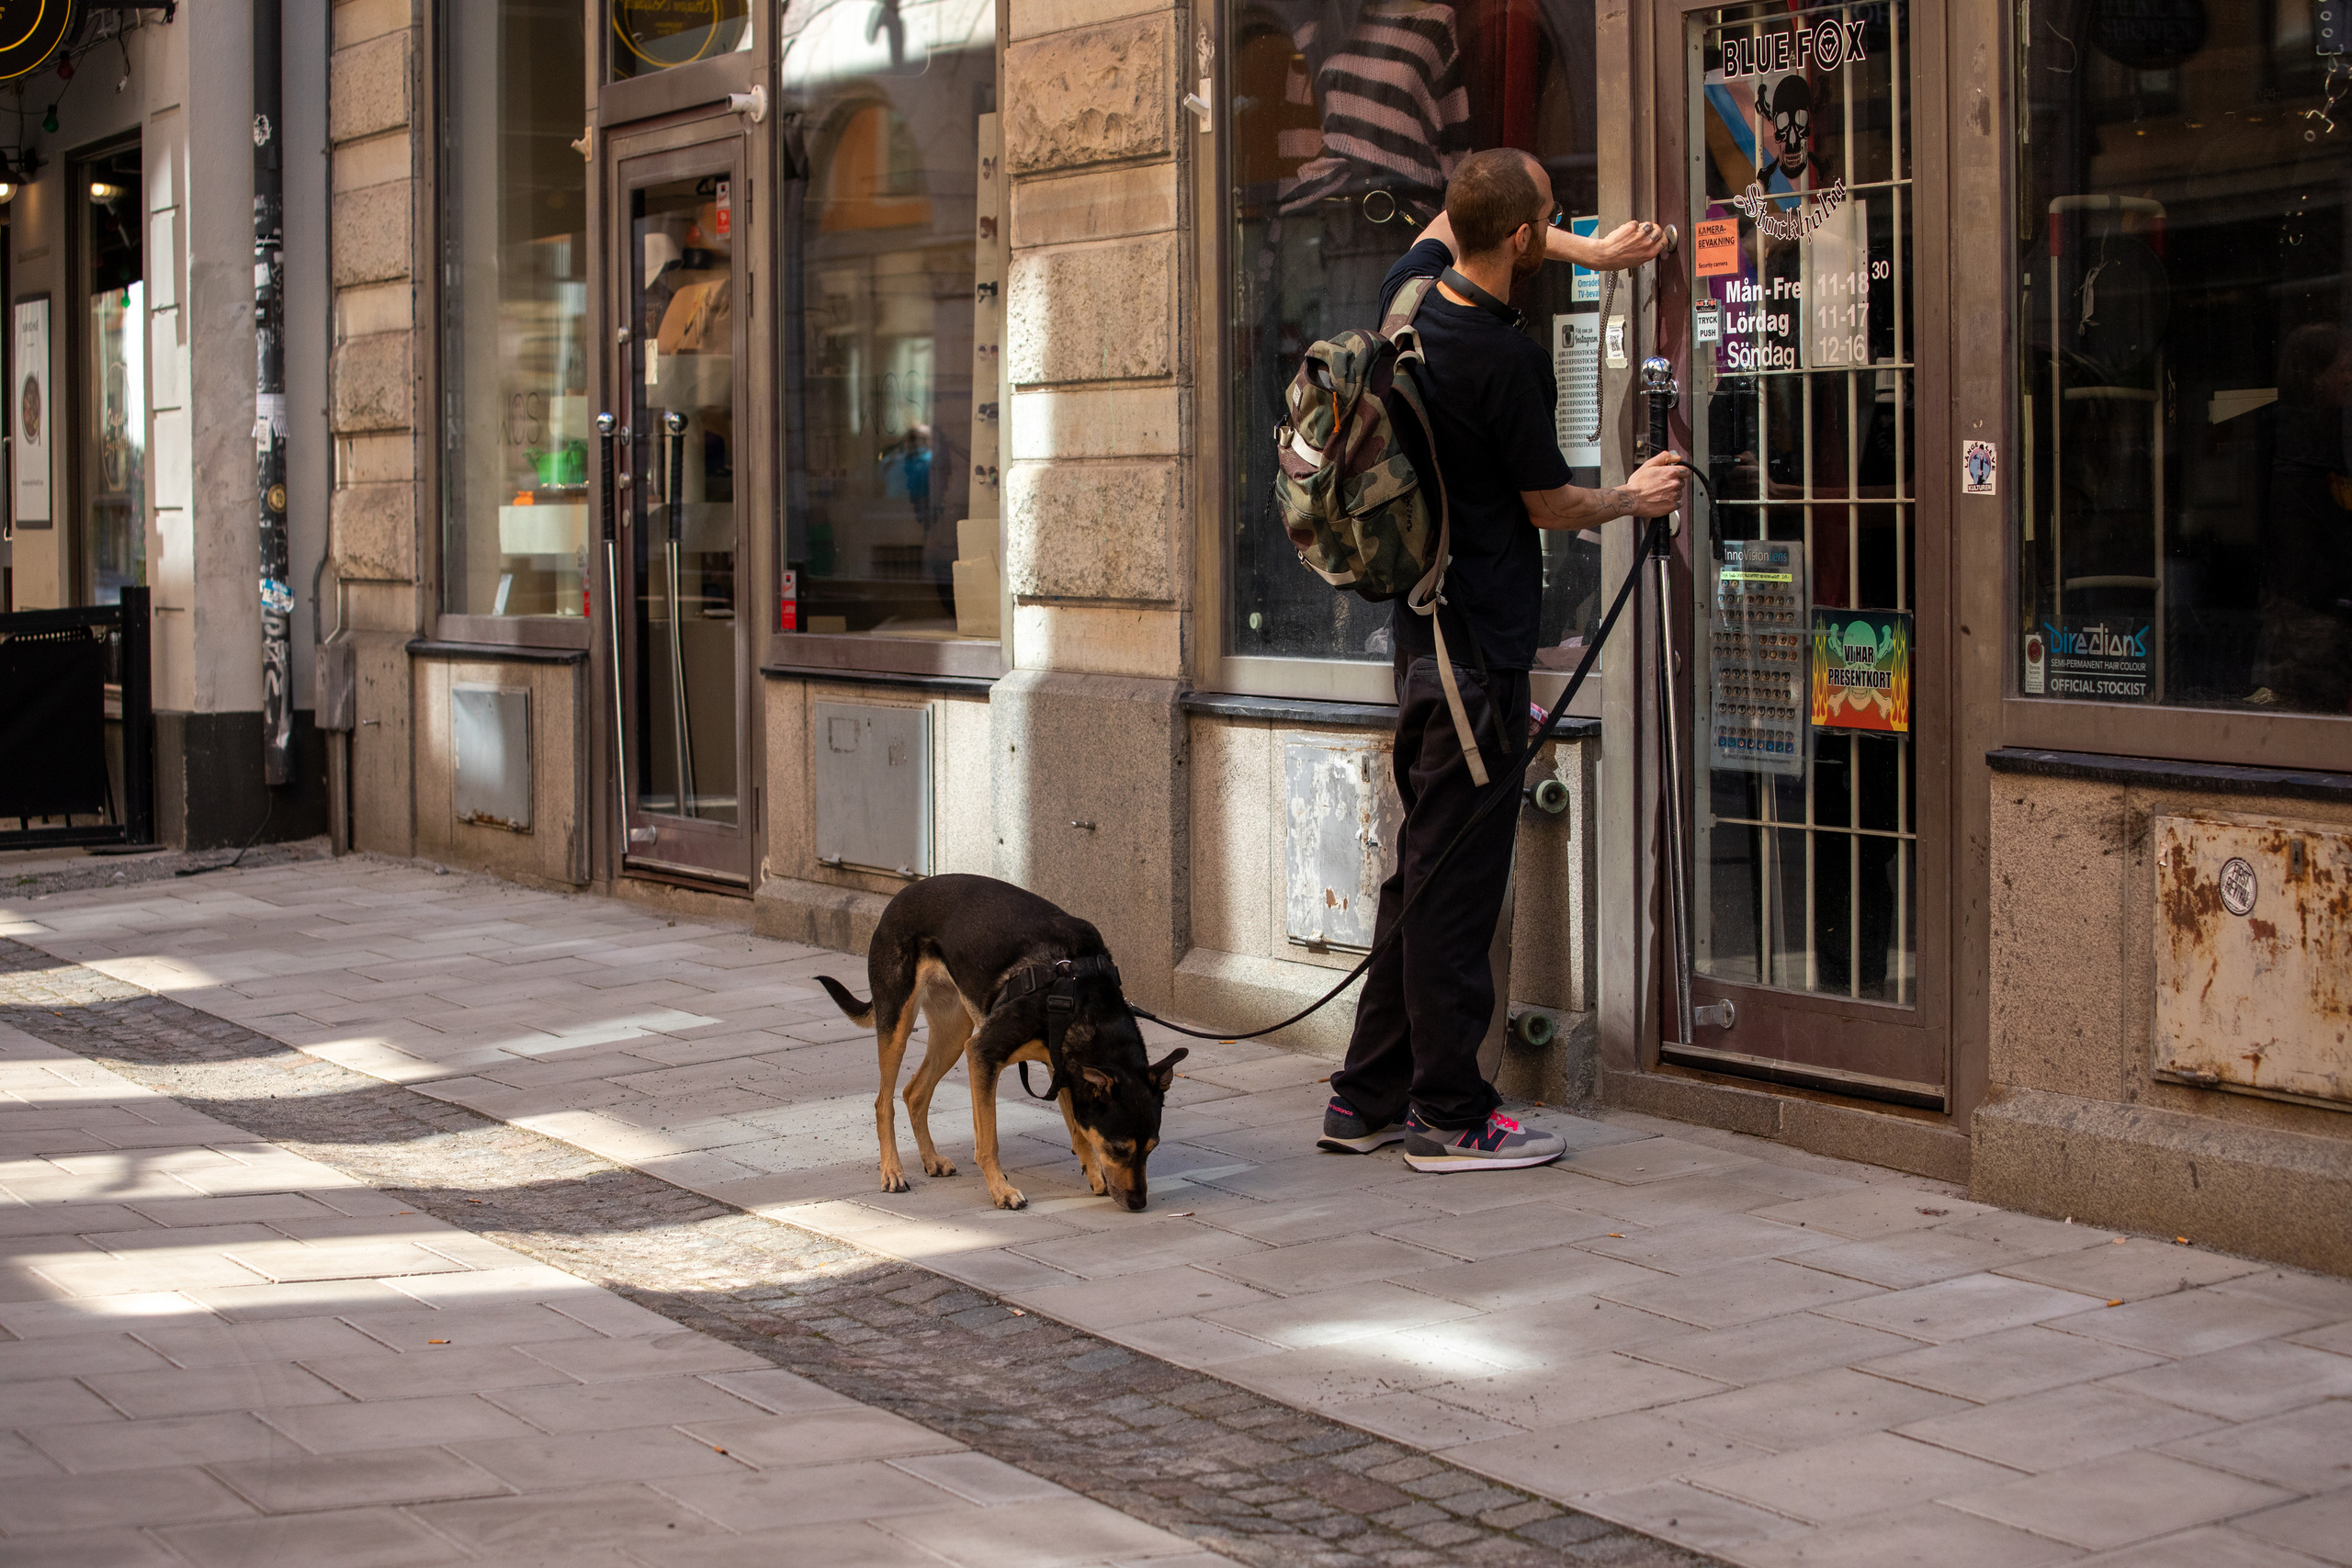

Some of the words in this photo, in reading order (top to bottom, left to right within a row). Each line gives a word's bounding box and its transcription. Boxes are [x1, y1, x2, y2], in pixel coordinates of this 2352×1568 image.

[1723, 31, 1790, 79] BLUE
[1796, 19, 1866, 72] FOX
[1733, 178, 1847, 244] Stockholm
[1698, 224, 1726, 235] KAMERA-
[1698, 236, 1736, 248] BEVAKNING
[1817, 270, 1870, 297] 11-18
[1871, 260, 1890, 280] 30
[1577, 289, 1600, 299] TV-beva
[1698, 316, 1718, 324] TRYCK
[1725, 310, 1790, 337] Lördag
[1817, 302, 1870, 329] 11-17
[1575, 333, 1599, 346] Instagram
[1700, 329, 1716, 337] PUSH
[1727, 340, 1796, 373] Söndag
[1819, 333, 1867, 364] 12-16
[1968, 484, 1992, 493] KULTUREN
[1724, 547, 1788, 563] InnoVisionLens
[2044, 621, 2149, 658] Directions
[1844, 645, 1854, 662] VI
[1855, 645, 1874, 663] HAR
[2051, 658, 2104, 670] SEMI-PERMANENT
[2104, 661, 2120, 671] HAIR
[2120, 661, 2146, 671] COLOUR
[1827, 668, 1893, 689] PRESENTKORT
[2051, 678, 2095, 694] OFFICIAL
[2097, 682, 2147, 696] STOCKIST
